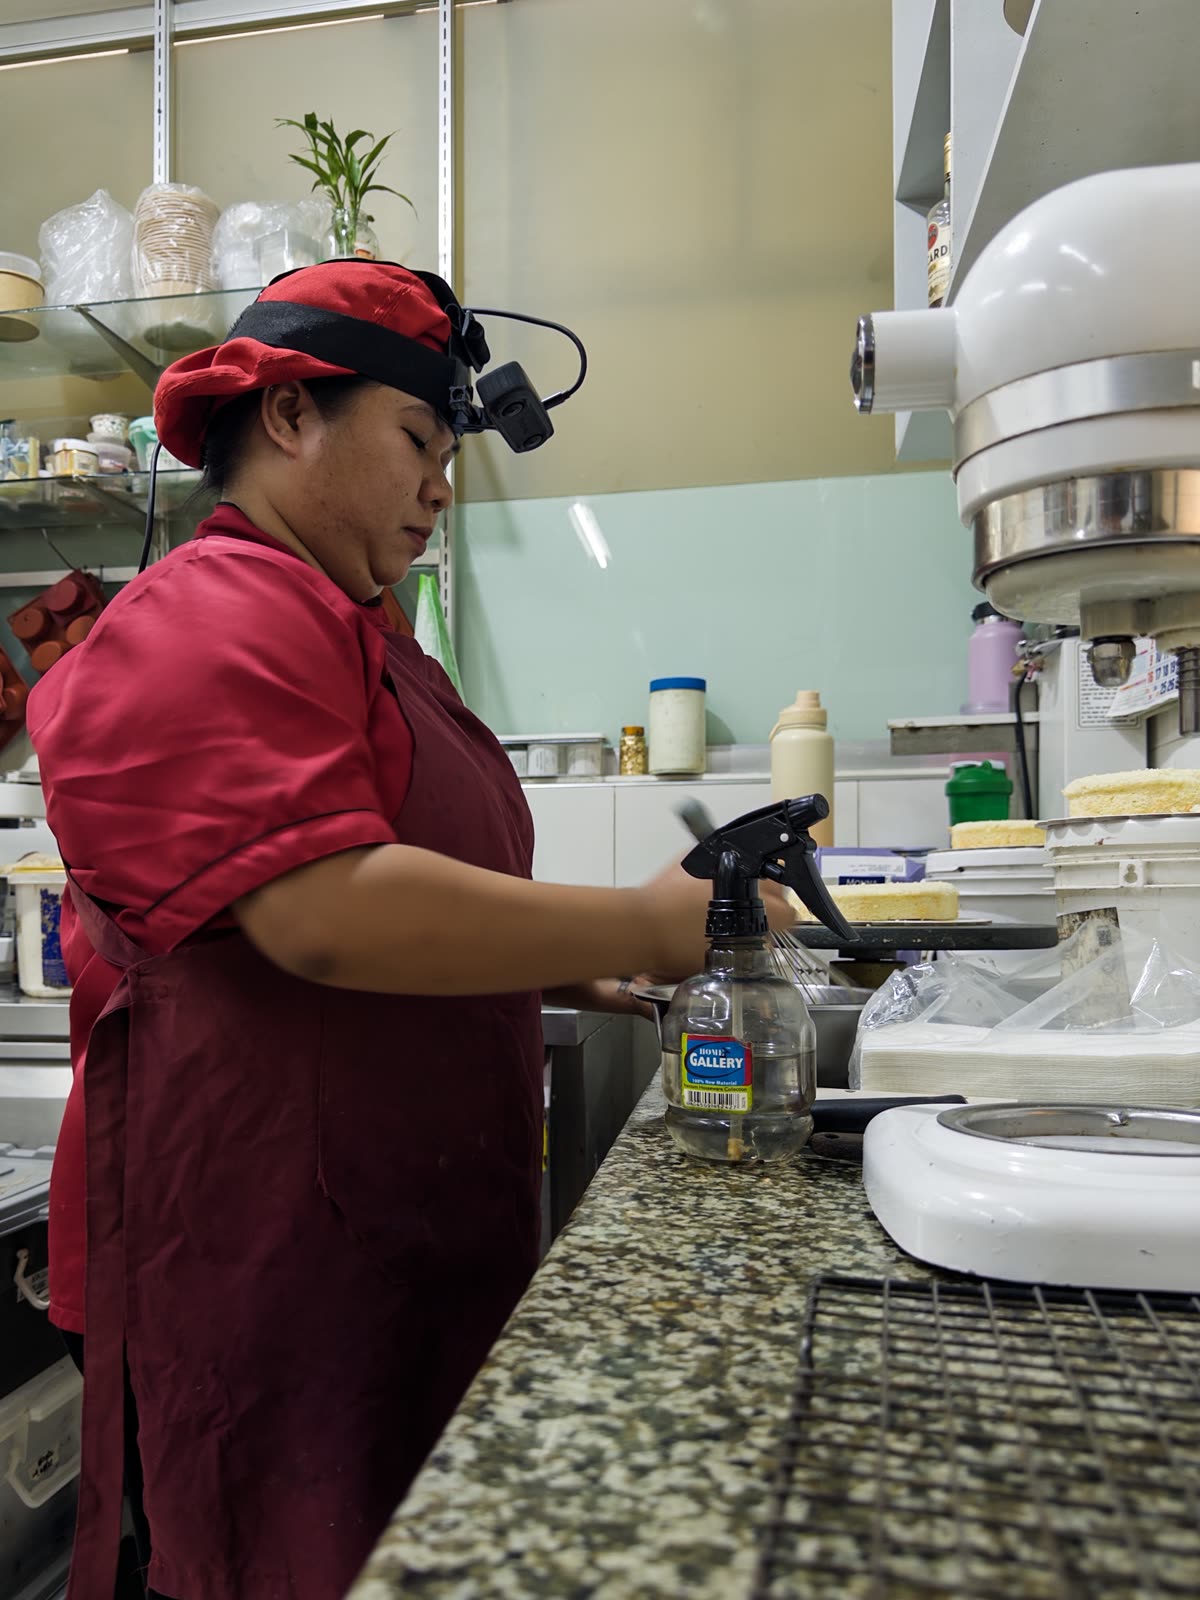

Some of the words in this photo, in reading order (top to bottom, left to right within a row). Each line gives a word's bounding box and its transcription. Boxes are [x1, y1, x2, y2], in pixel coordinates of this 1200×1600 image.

[928, 243, 950, 263] ARD
[1155, 667, 1162, 681] 17
[699, 1048, 726, 1057] HOME
[689, 1052, 744, 1069] GALLERY
